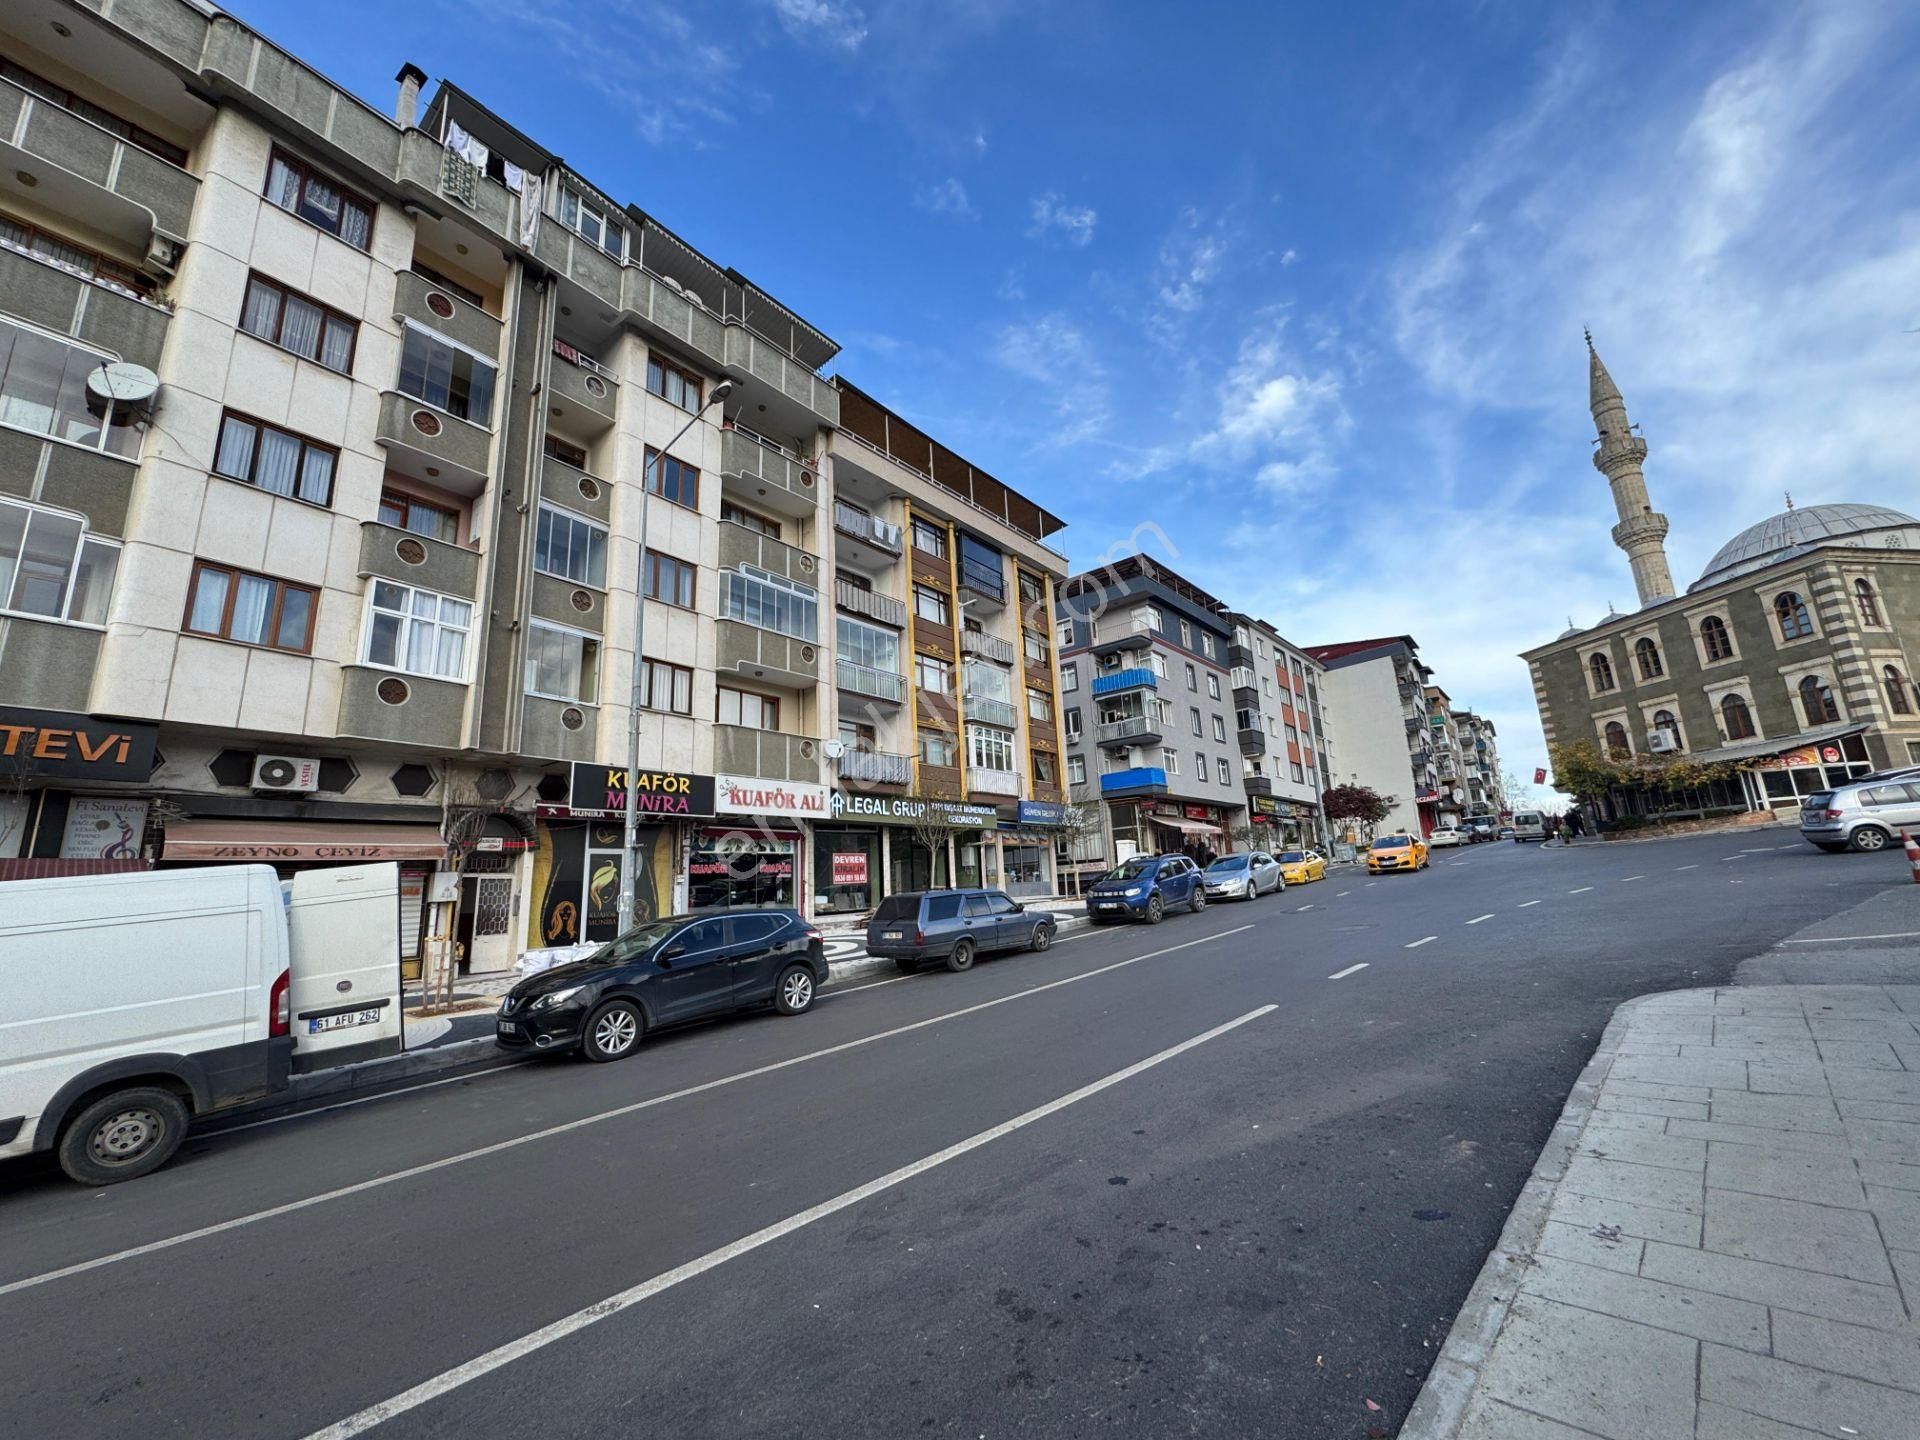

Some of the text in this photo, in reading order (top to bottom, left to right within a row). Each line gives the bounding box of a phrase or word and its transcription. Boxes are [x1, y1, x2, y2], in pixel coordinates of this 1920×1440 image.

[729, 787, 826, 811] KUAFÖR ALİ
[846, 796, 890, 816] LEGAL
[214, 845, 382, 859] ZEYNO ÇEYİZ
[834, 855, 865, 864] DEVREN
[317, 1019, 329, 1029] 61
[335, 1014, 354, 1026] AFU
[359, 1010, 378, 1022] 262
